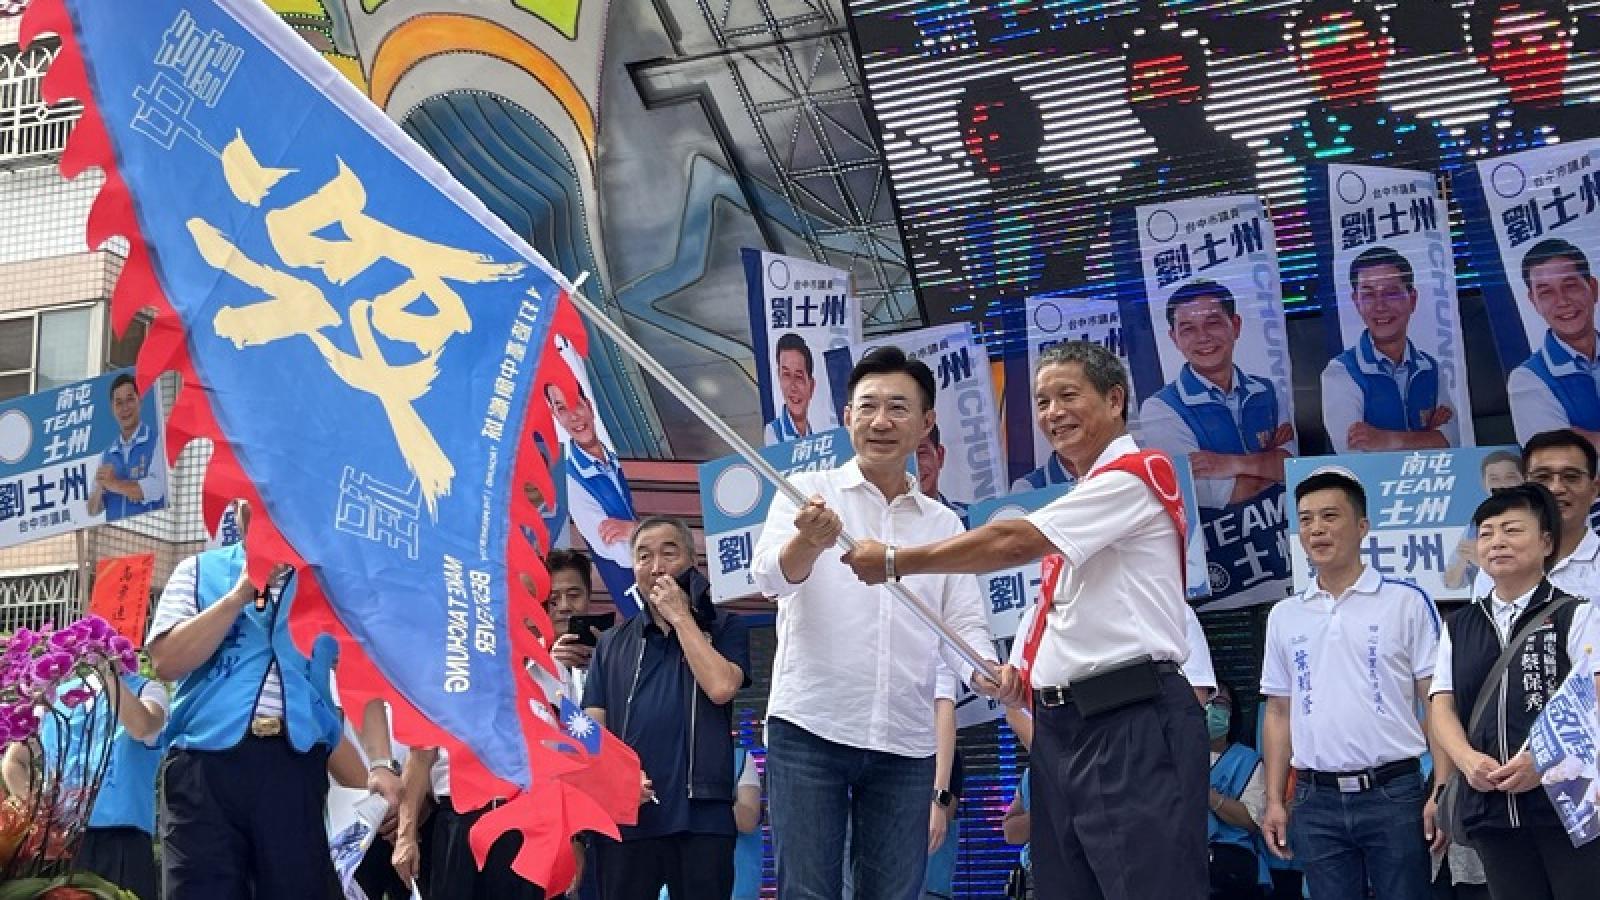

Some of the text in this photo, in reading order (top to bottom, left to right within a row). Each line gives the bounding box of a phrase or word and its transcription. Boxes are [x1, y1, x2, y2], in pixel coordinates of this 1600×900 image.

[1534, 154, 1591, 188] 台中市議員
[1373, 184, 1417, 199] 台中市議員
[1185, 208, 1241, 234] 台中市議員
[1341, 196, 1437, 250] 劉士州
[1153, 217, 1264, 288] 劉士州
[771, 294, 847, 329] 劉士州
[56, 384, 92, 411] 南屯
[43, 404, 94, 434] TEAM
[42, 425, 92, 465] 士州
[792, 434, 833, 464] 南屯
[1401, 452, 1454, 476] 南屯
[1379, 475, 1457, 496] TEAM
[19, 509, 71, 533] 台中市議員
[1377, 495, 1451, 527] 士州
